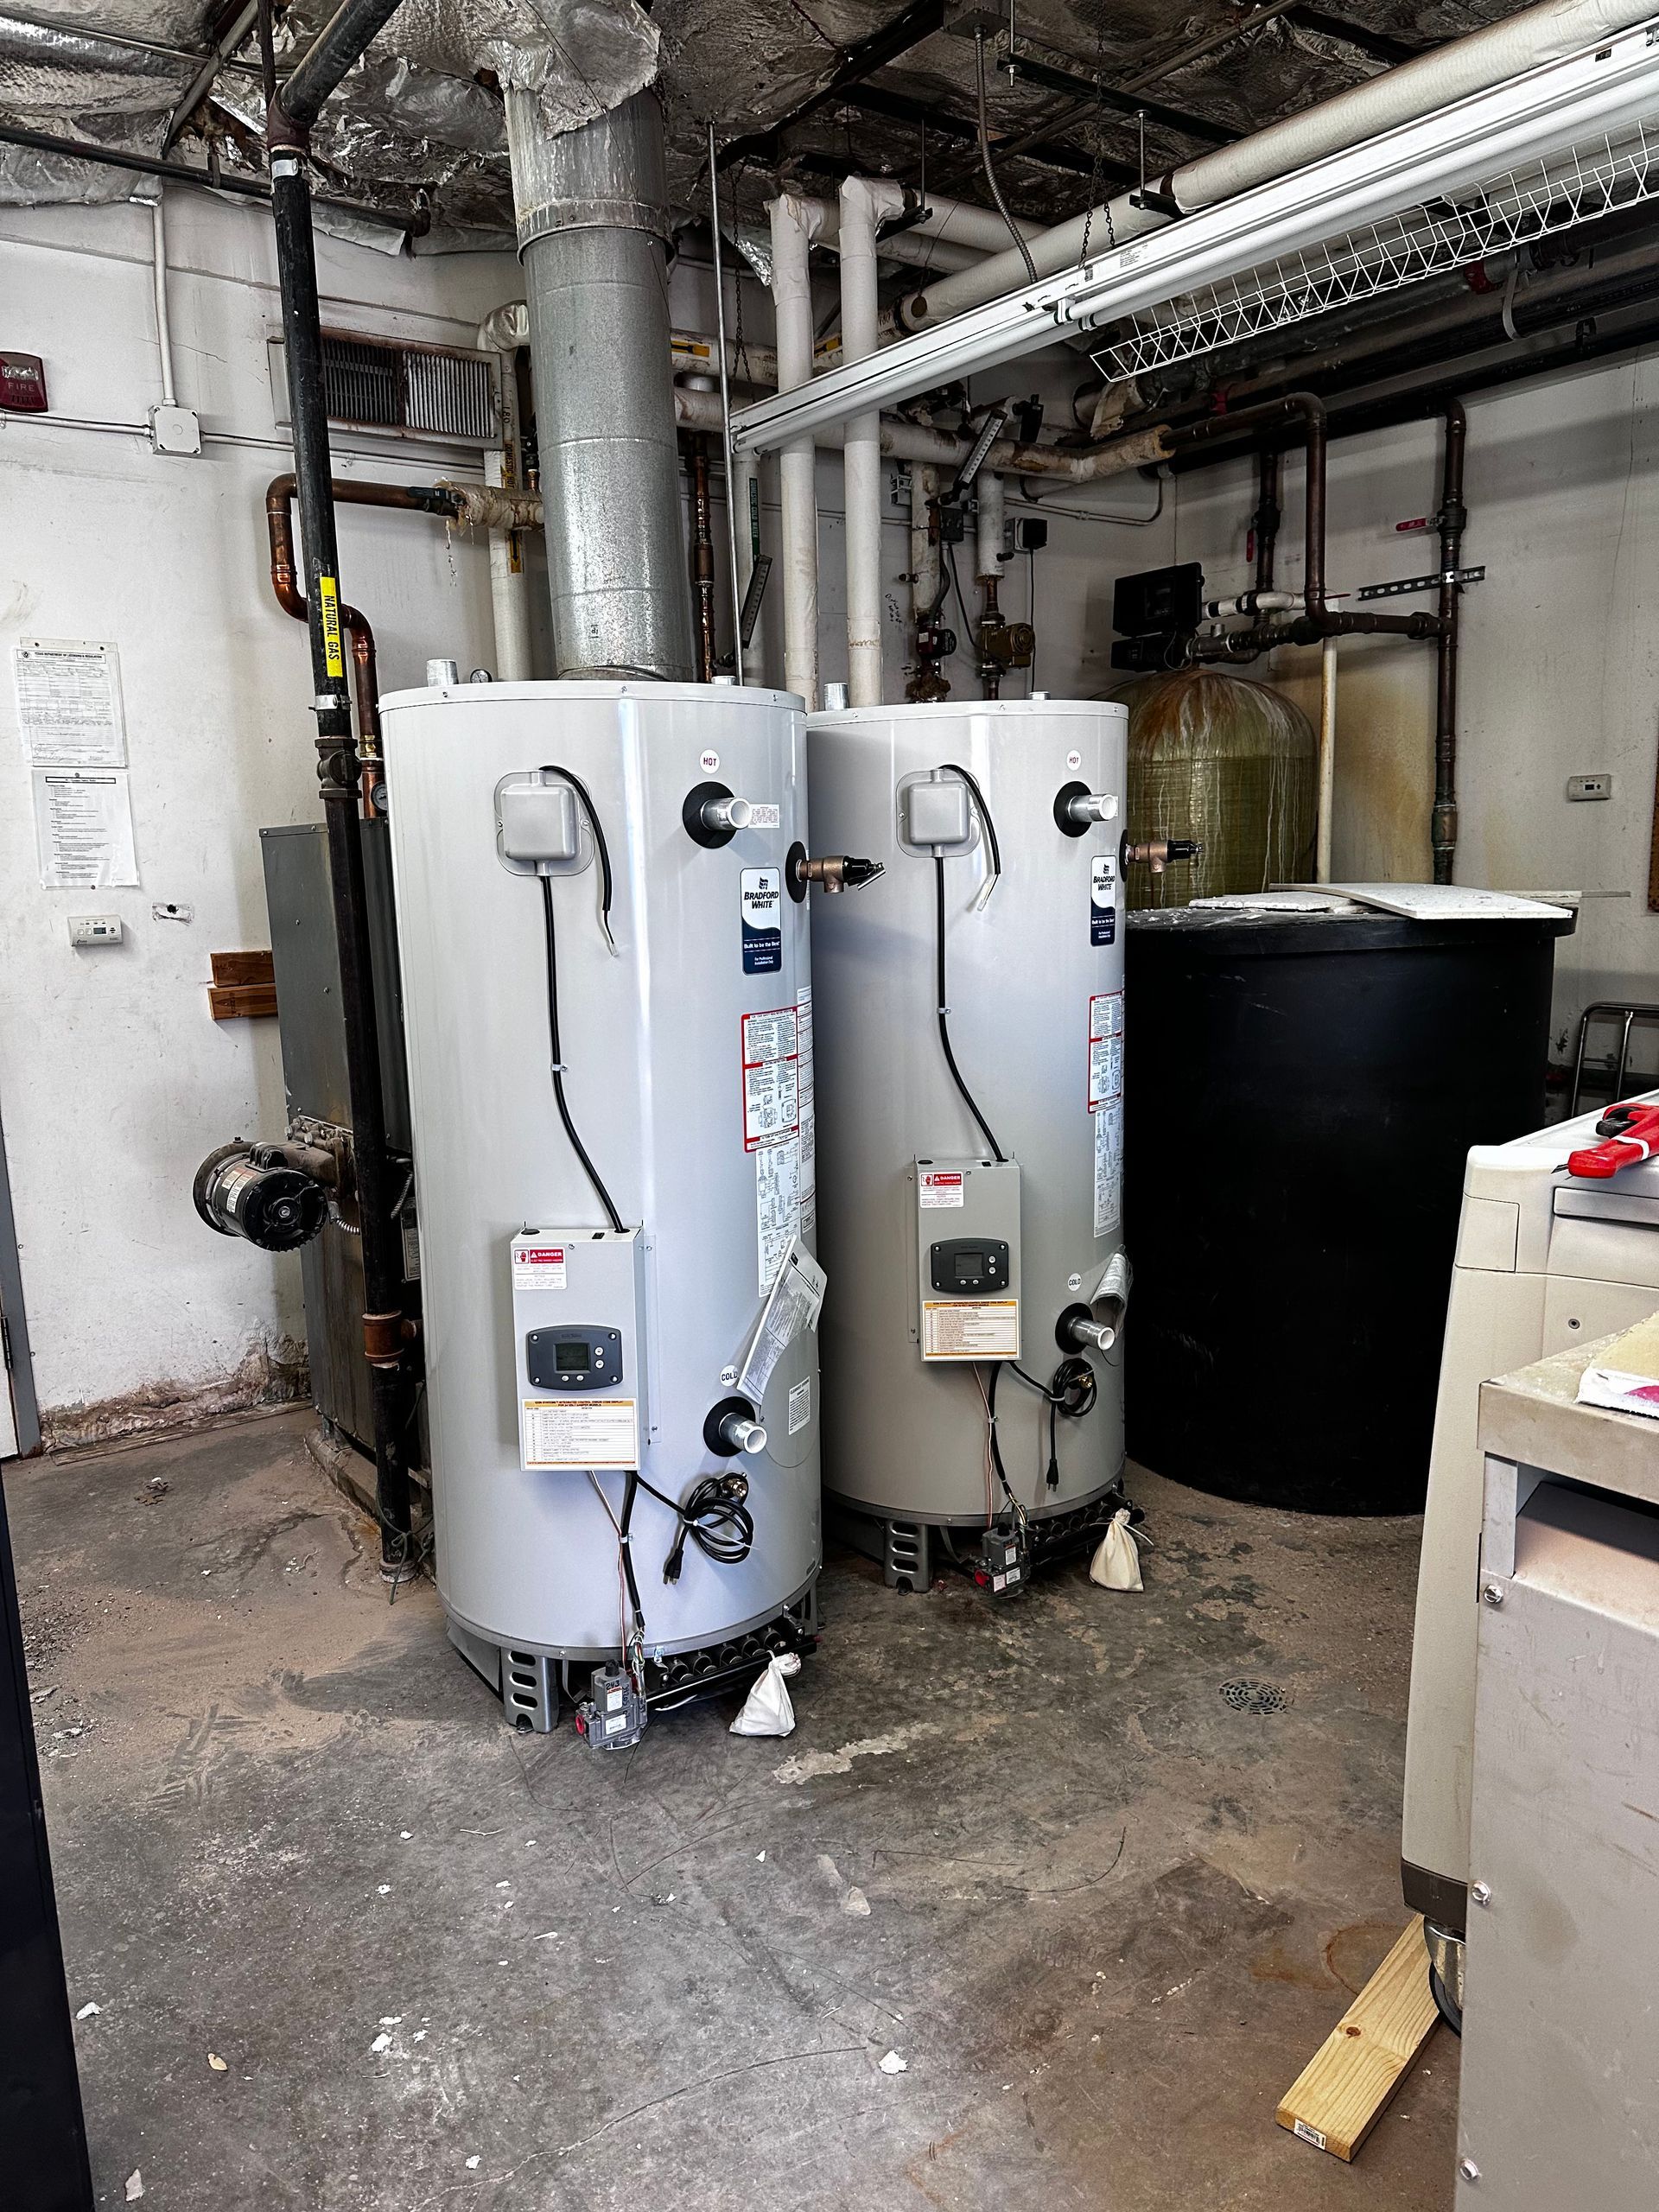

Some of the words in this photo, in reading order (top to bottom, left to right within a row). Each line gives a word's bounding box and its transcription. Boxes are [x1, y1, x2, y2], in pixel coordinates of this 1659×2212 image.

[8, 382, 35, 391] FIRE
[324, 595, 338, 638] NATURAL
[327, 642, 340, 660] GAS
[703, 757, 717, 766] HOT
[1093, 875, 1116, 884] BRADFORD
[744, 891, 779, 900] BRADFORD
[752, 900, 773, 909] WHITE
[721, 1371, 738, 1382] COLD
[606, 1681, 620, 1690] 243
